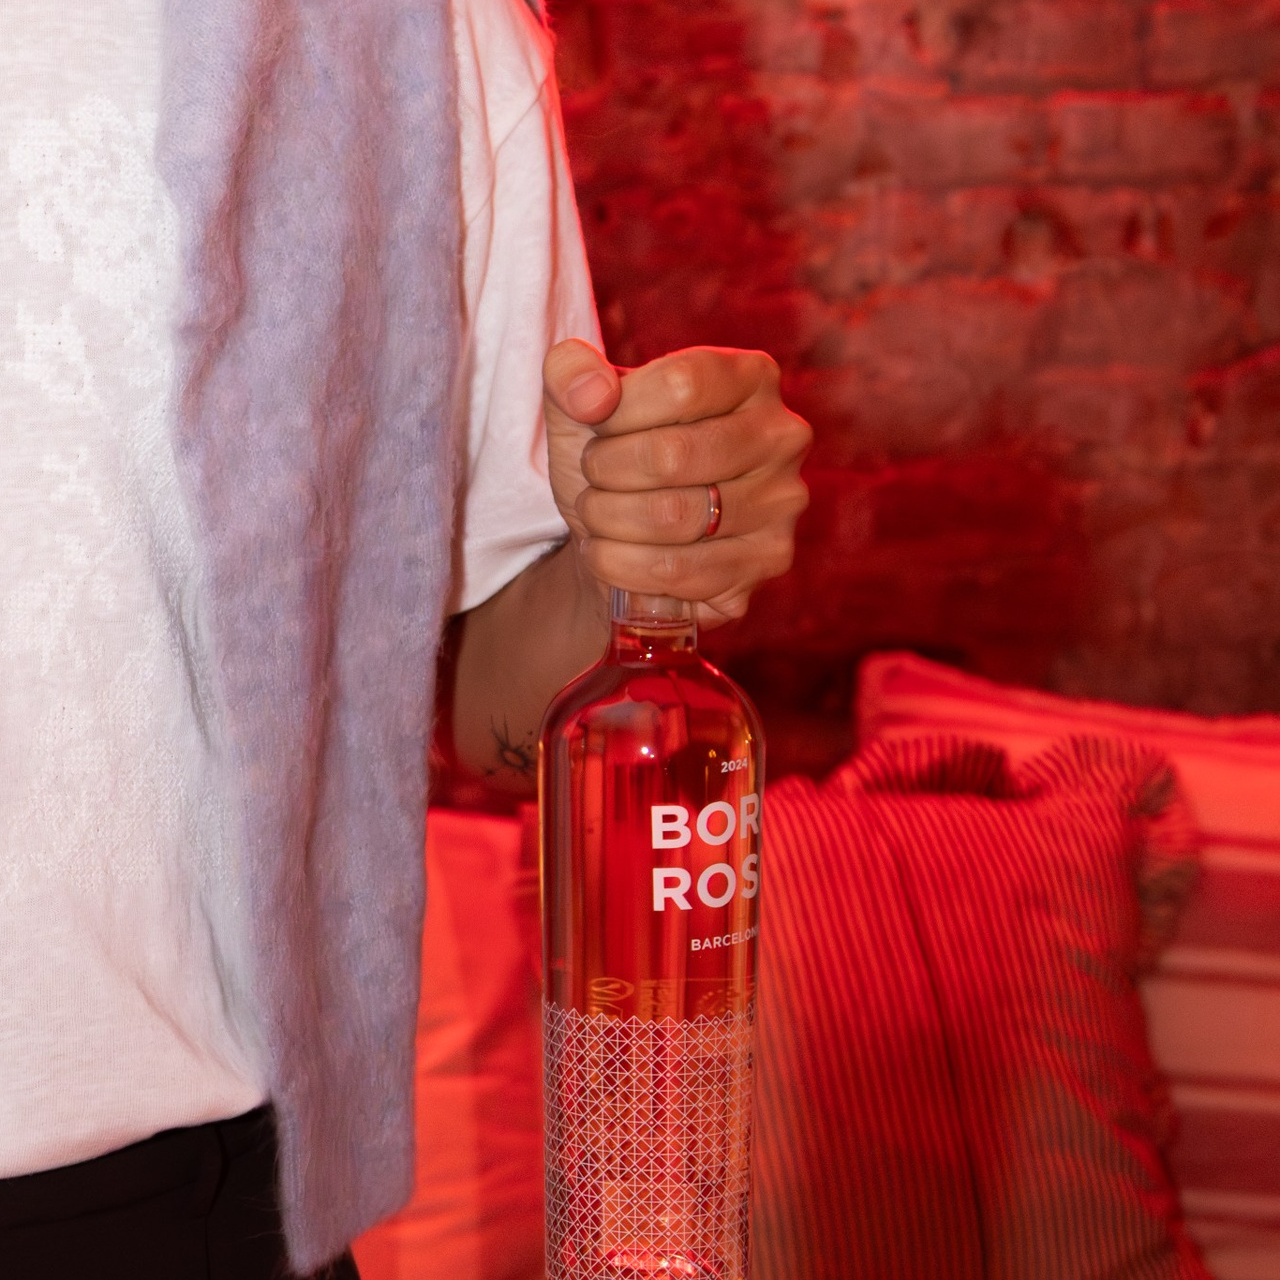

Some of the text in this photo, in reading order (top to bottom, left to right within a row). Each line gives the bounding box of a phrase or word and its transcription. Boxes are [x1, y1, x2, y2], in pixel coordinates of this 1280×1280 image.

[721, 757, 748, 773] 2024
[651, 793, 760, 850] BOR
[652, 853, 759, 912] ROS
[691, 924, 759, 952] BARCELON
